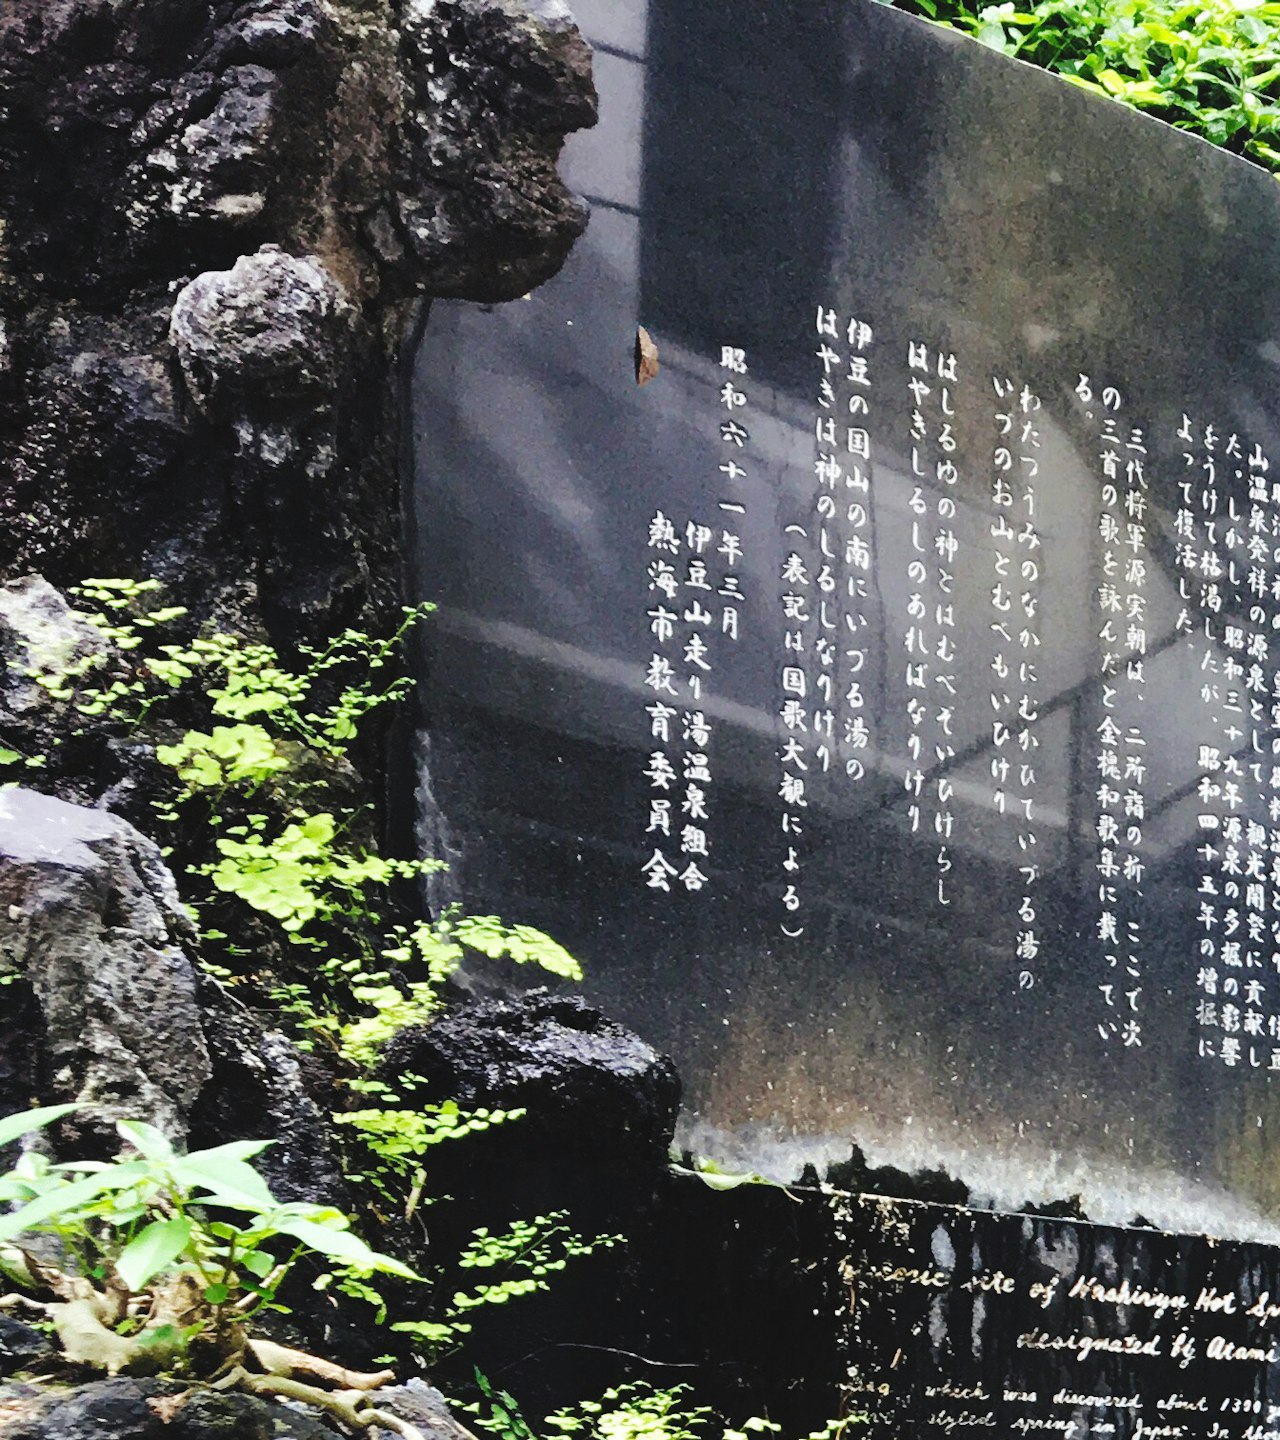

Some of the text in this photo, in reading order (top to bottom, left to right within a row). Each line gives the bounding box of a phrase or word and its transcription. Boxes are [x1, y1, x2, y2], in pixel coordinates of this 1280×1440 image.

[1075, 373, 1094, 419] る。
[717, 345, 748, 640] 昭和六十一年三月
[813, 305, 841, 773] はやきは神のしるしなりけり
[844, 317, 872, 781] 伊豆の国山の南にいづる湯の
[641, 510, 680, 893] 熱海市教育委員会
[678, 520, 712, 892] 伊豆山走り湯温泉組合
[1016, 1327, 1161, 1362] designated
[1171, 1332, 1196, 1369] by
[1206, 1336, 1280, 1363] Atami
[1028, 1274, 1060, 1308] of
[1068, 1274, 1189, 1319] Hashiriyu
[1194, 1287, 1237, 1314] Hot
[1003, 1389, 1037, 1402] was
[1053, 1387, 1143, 1408] discovered
[1157, 1391, 1209, 1412] about
[1011, 1414, 1078, 1439] spring
[1090, 1417, 1116, 1433] in
[1207, 1422, 1229, 1439] In
